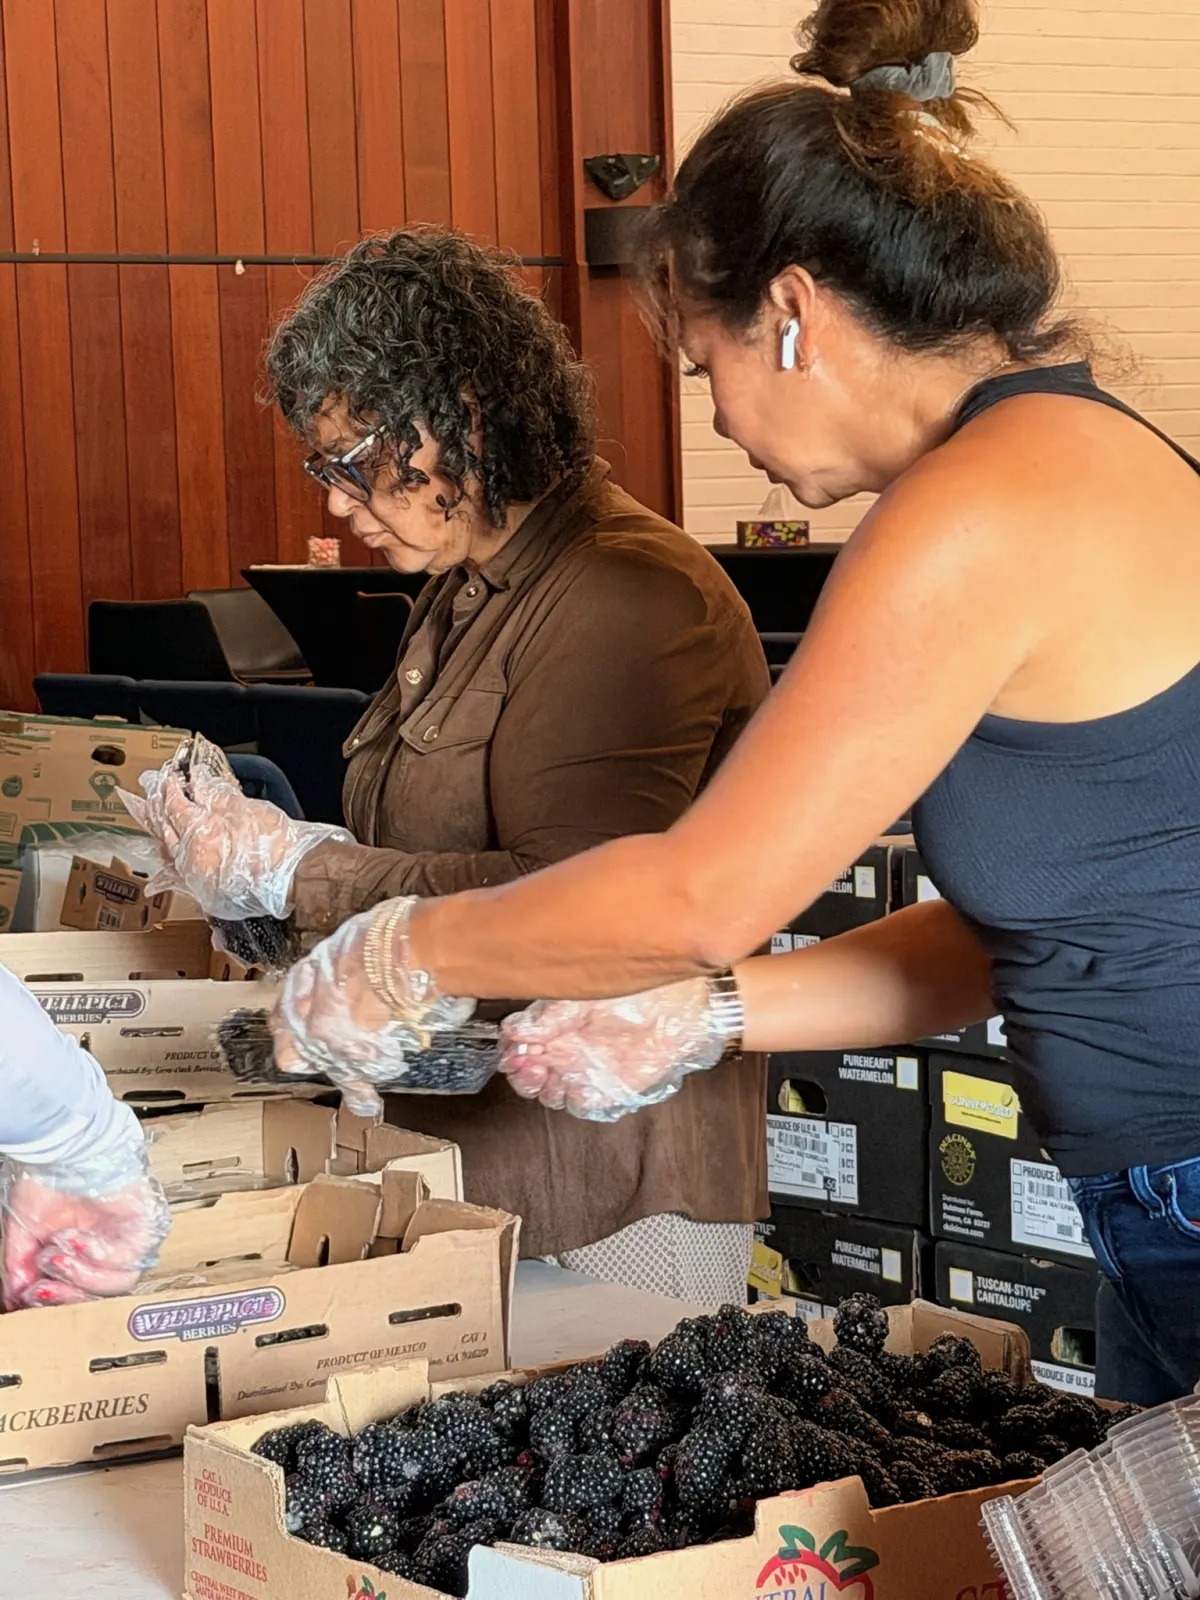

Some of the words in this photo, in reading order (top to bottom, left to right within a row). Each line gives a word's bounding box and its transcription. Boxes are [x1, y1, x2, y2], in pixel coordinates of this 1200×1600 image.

[55, 1013, 103, 1023] BERRIES
[164, 1050, 210, 1060] PRODUCT
[838, 1067, 895, 1085] WATERMELON
[1023, 1165, 1055, 1181] PRODUCE
[831, 1252, 880, 1275] WATERMELON
[976, 1289, 1032, 1313] CANTALOUPE
[182, 1322, 237, 1341] BERRIES
[461, 1331, 480, 1344] CAT
[316, 1350, 370, 1370] PRODUCT
[370, 1348, 385, 1360] OF
[385, 1341, 427, 1357] MEXICO
[1065, 1372, 1076, 1385] OF
[194, 1478, 233, 1504] PRODUCE
[196, 1492, 208, 1508] OF
[204, 1522, 254, 1559] PREMIUM
[191, 1536, 268, 1583] STRAWBERRIES
[190, 1569, 219, 1593] CENTRAL
